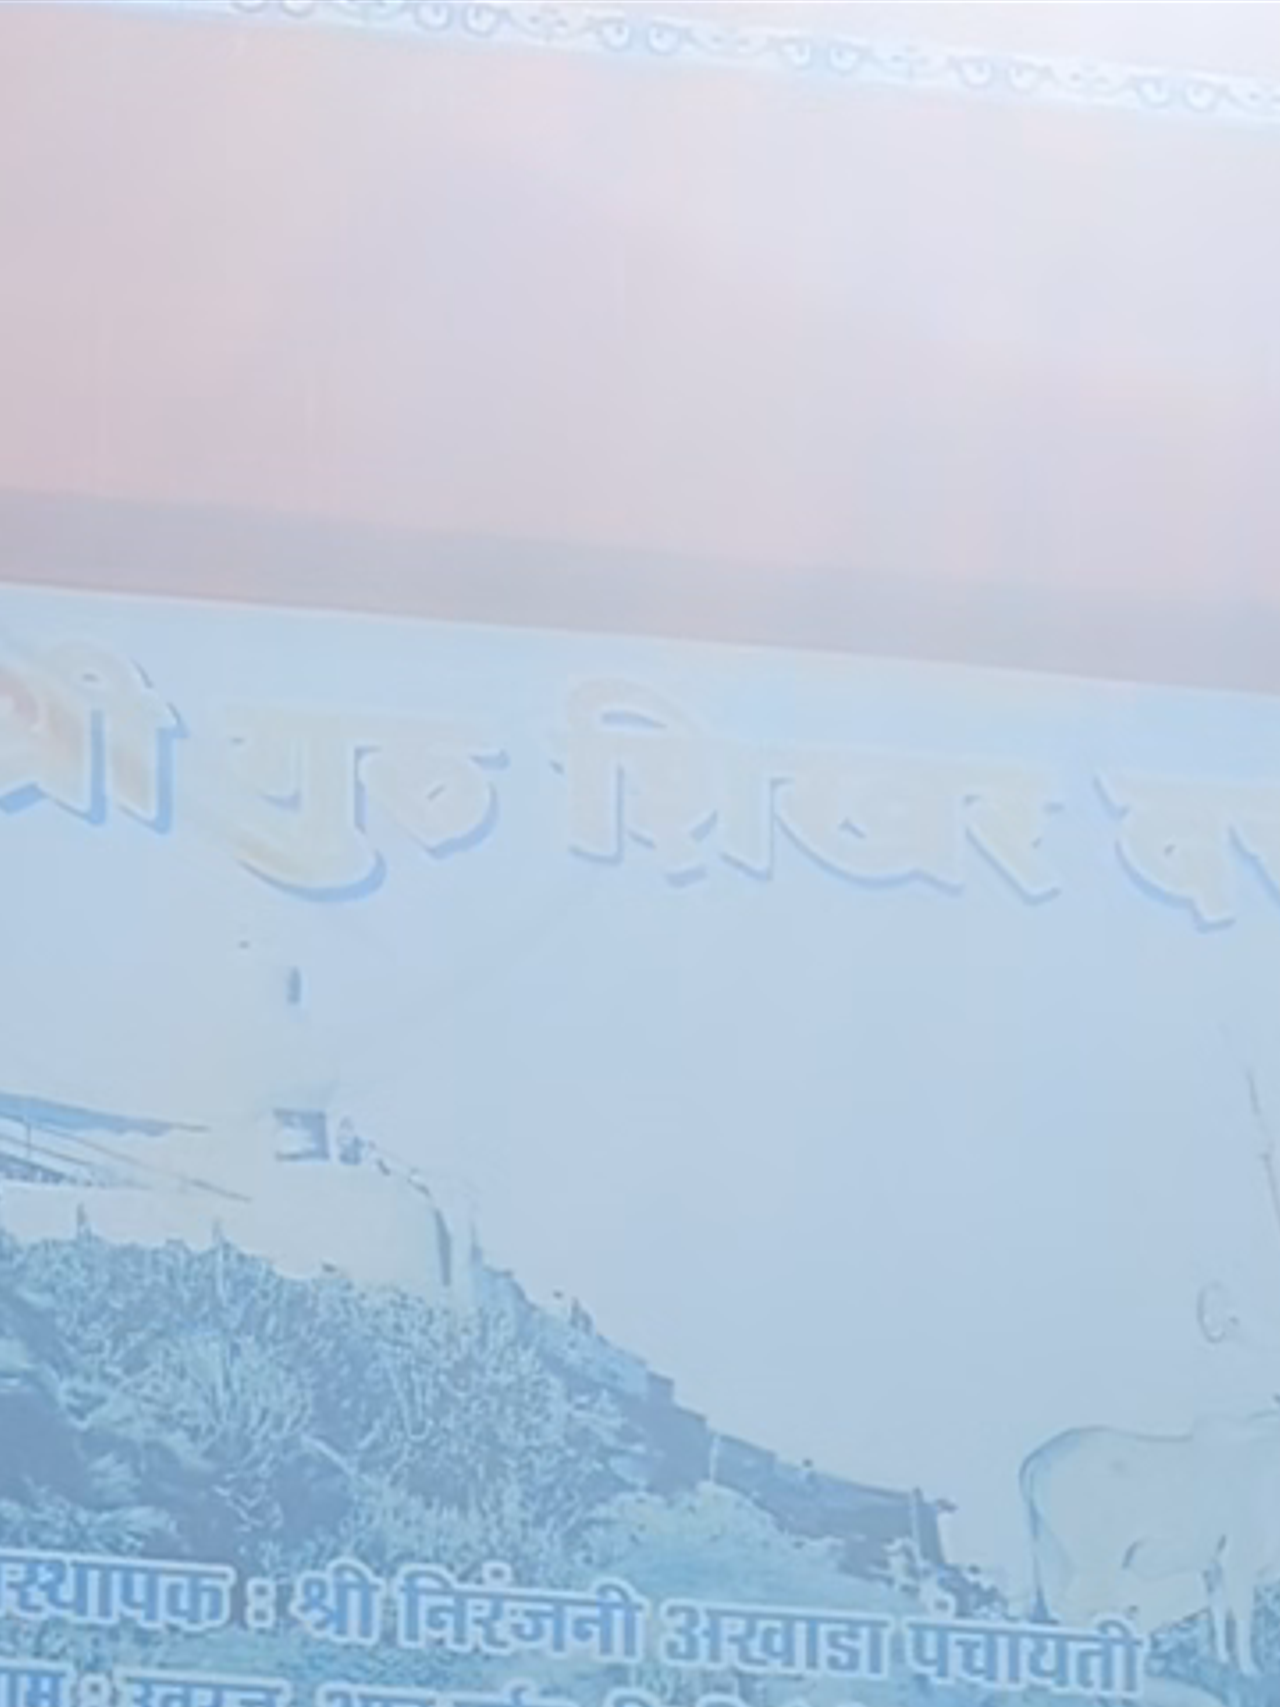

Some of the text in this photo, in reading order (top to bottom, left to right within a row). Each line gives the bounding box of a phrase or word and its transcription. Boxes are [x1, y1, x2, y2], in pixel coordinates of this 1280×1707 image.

[548, 675, 1062, 908] शिखर
[290, 1557, 385, 1645] श्री
[394, 1558, 643, 1661] निरंजनी
[904, 1600, 1148, 1700] पंचायती
